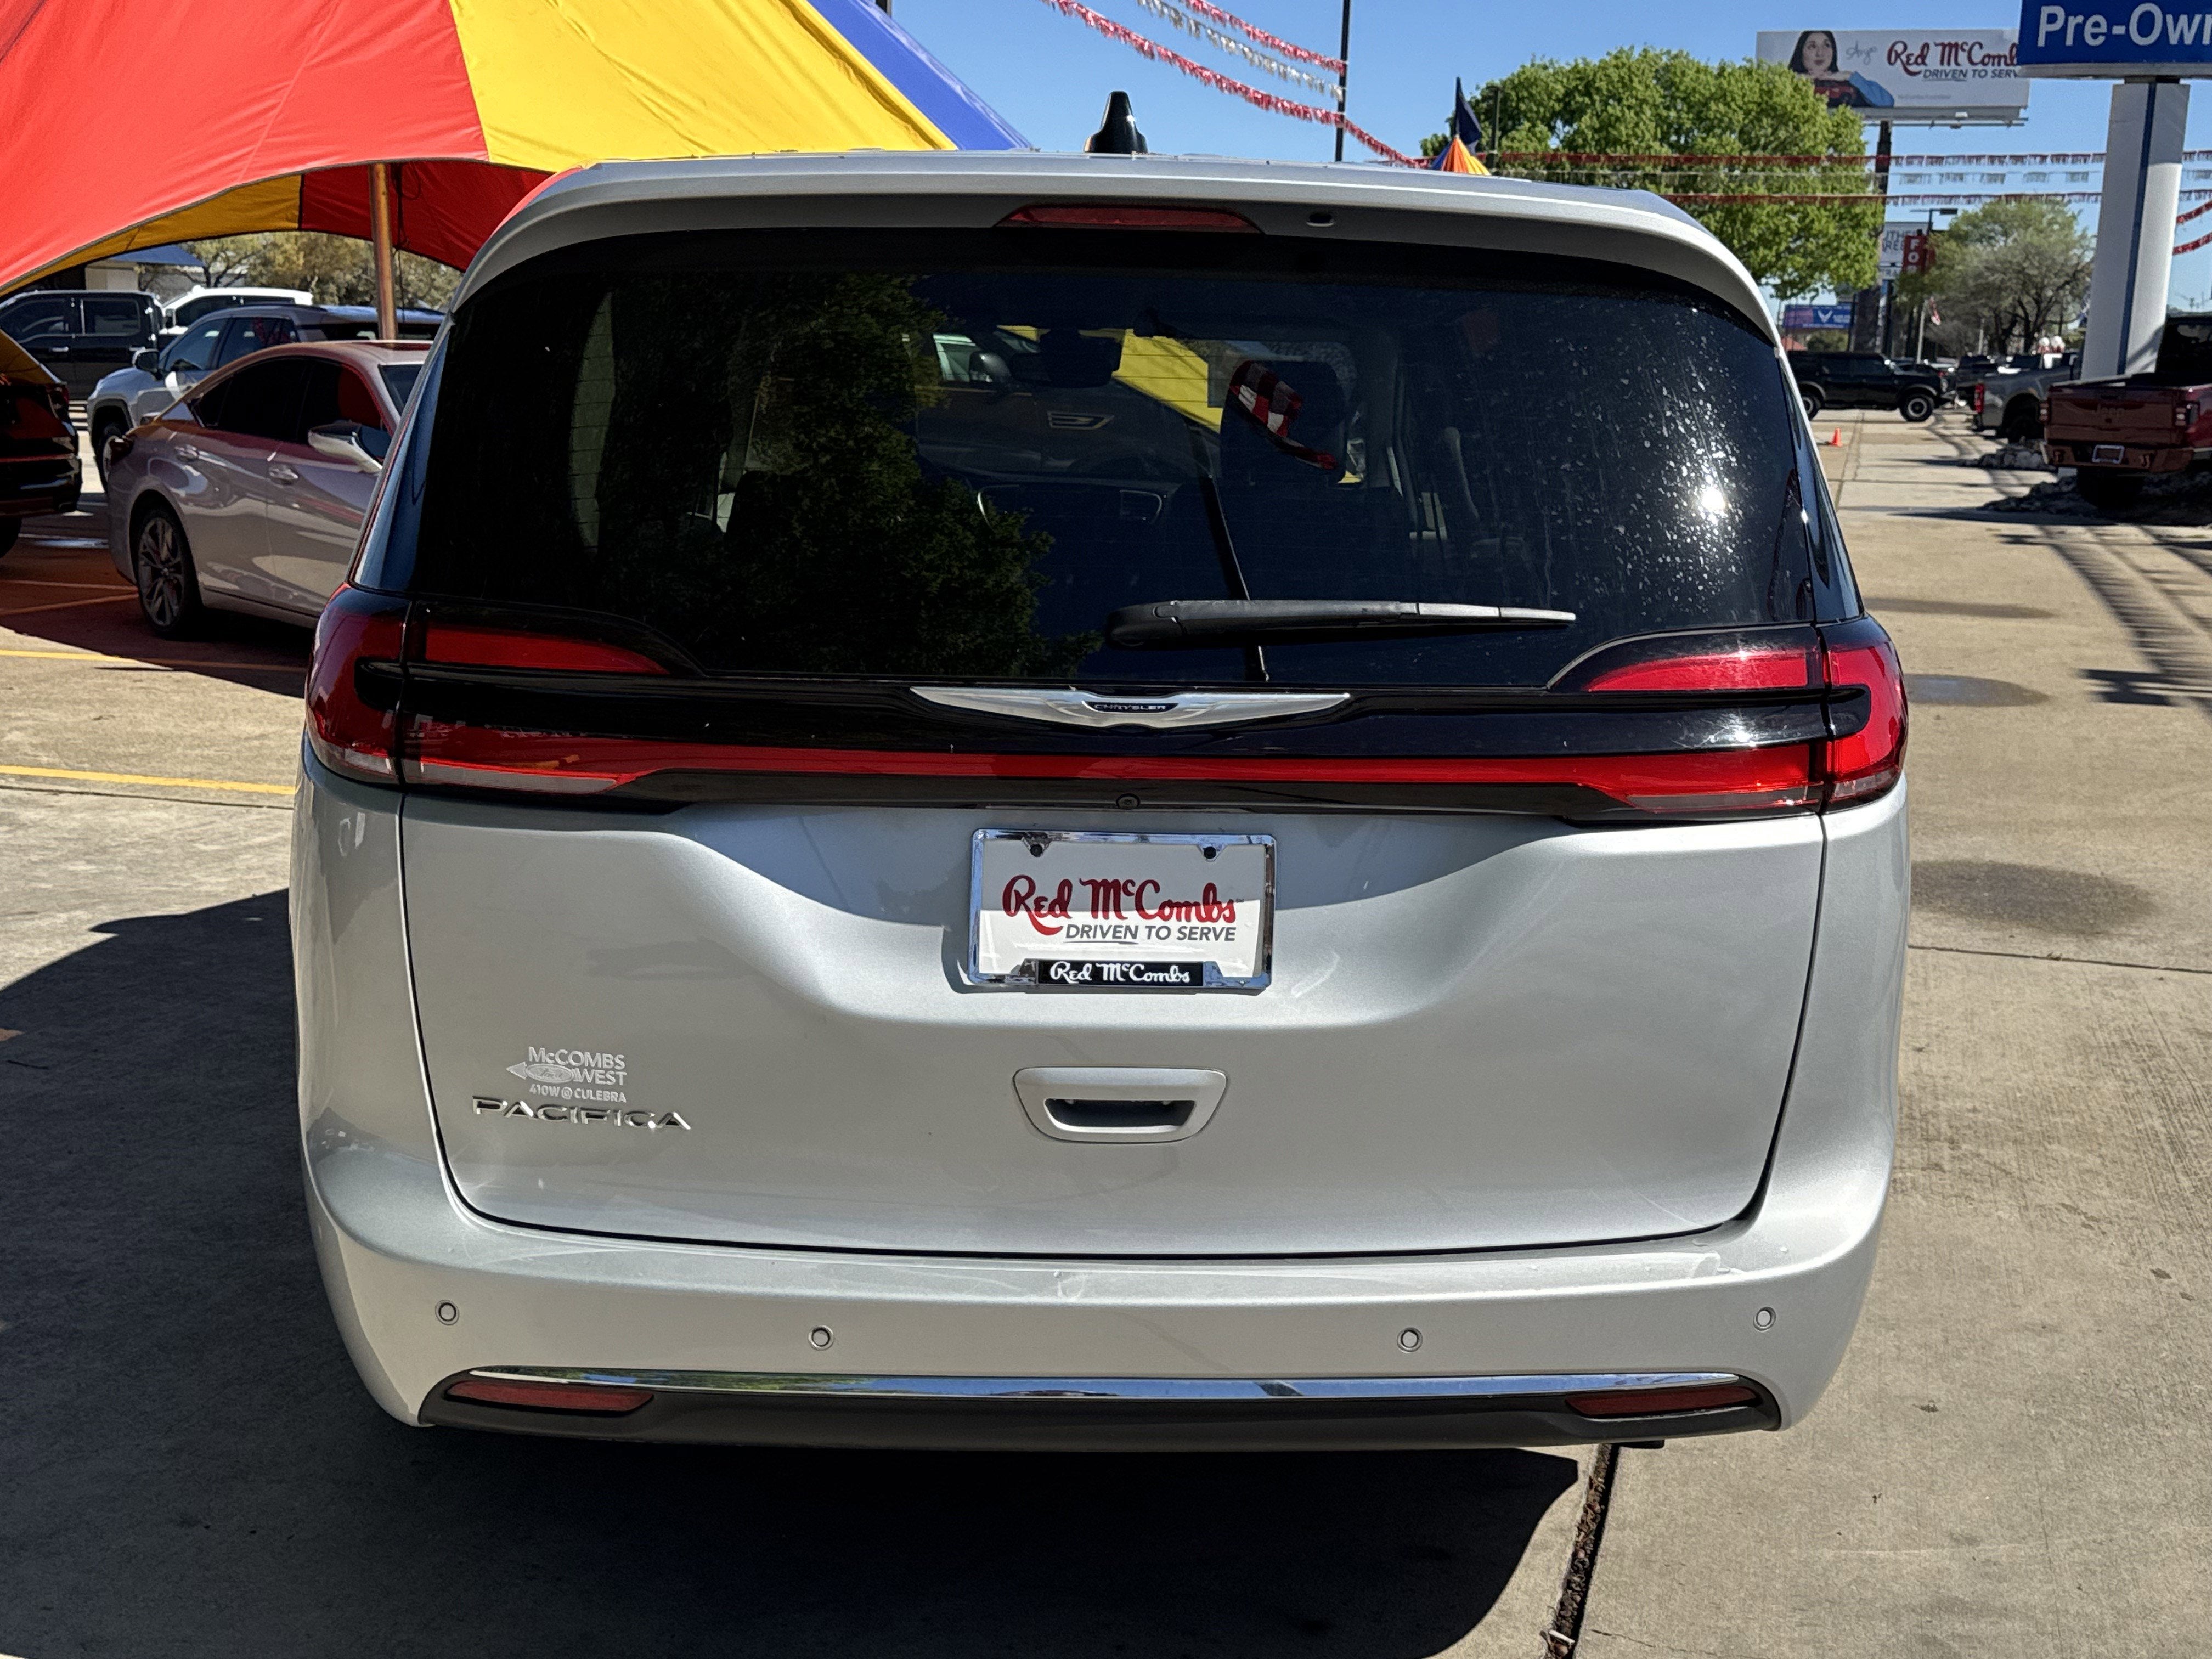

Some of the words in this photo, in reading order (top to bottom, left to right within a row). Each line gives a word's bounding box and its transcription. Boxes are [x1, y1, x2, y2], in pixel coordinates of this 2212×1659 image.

[1887, 40, 1929, 76] Red
[1933, 41, 2017, 67] McComb
[1922, 69, 1968, 78] DRIVEN
[1971, 69, 1988, 78] TO
[1002, 874, 1073, 936] Red
[1079, 879, 1236, 923] McCombs
[1065, 924, 1138, 940] DRIVEN
[1145, 925, 1172, 941] TO
[1177, 926, 1237, 942] SERVE
[1049, 961, 1093, 984] Red
[1096, 962, 1190, 983] McCombs
[528, 1046, 625, 1070] McCOMBS
[573, 1068, 627, 1086] WEST
[472, 1096, 691, 1130] PACIFICA
